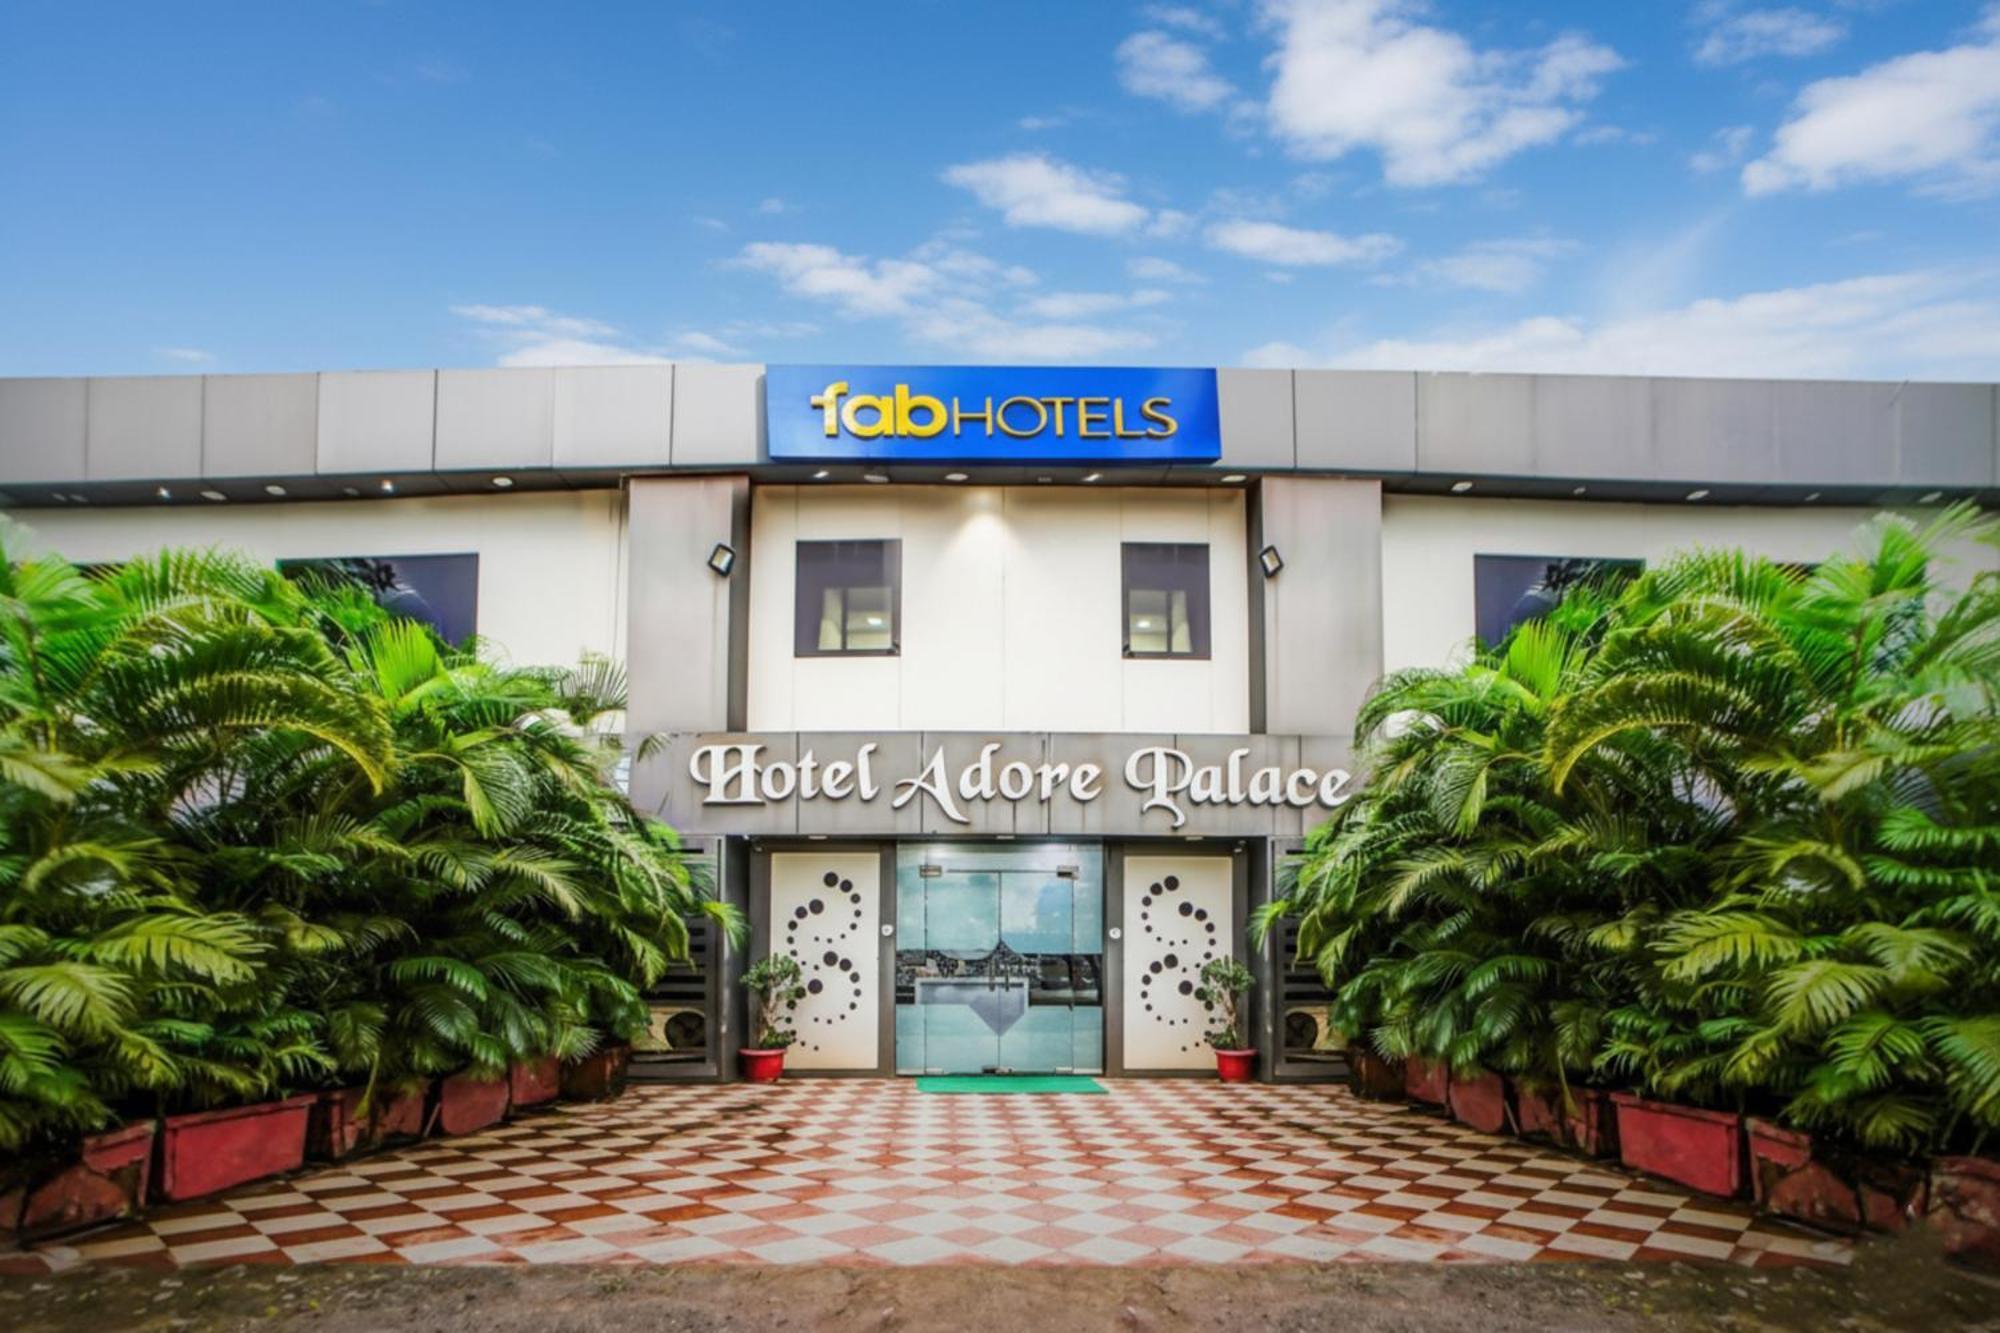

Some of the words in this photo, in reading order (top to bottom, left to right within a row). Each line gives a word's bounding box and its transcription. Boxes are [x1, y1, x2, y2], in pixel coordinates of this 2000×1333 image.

[689, 741, 879, 806] Hotel
[892, 742, 1102, 824] Adore
[1124, 746, 1352, 829] Palace
